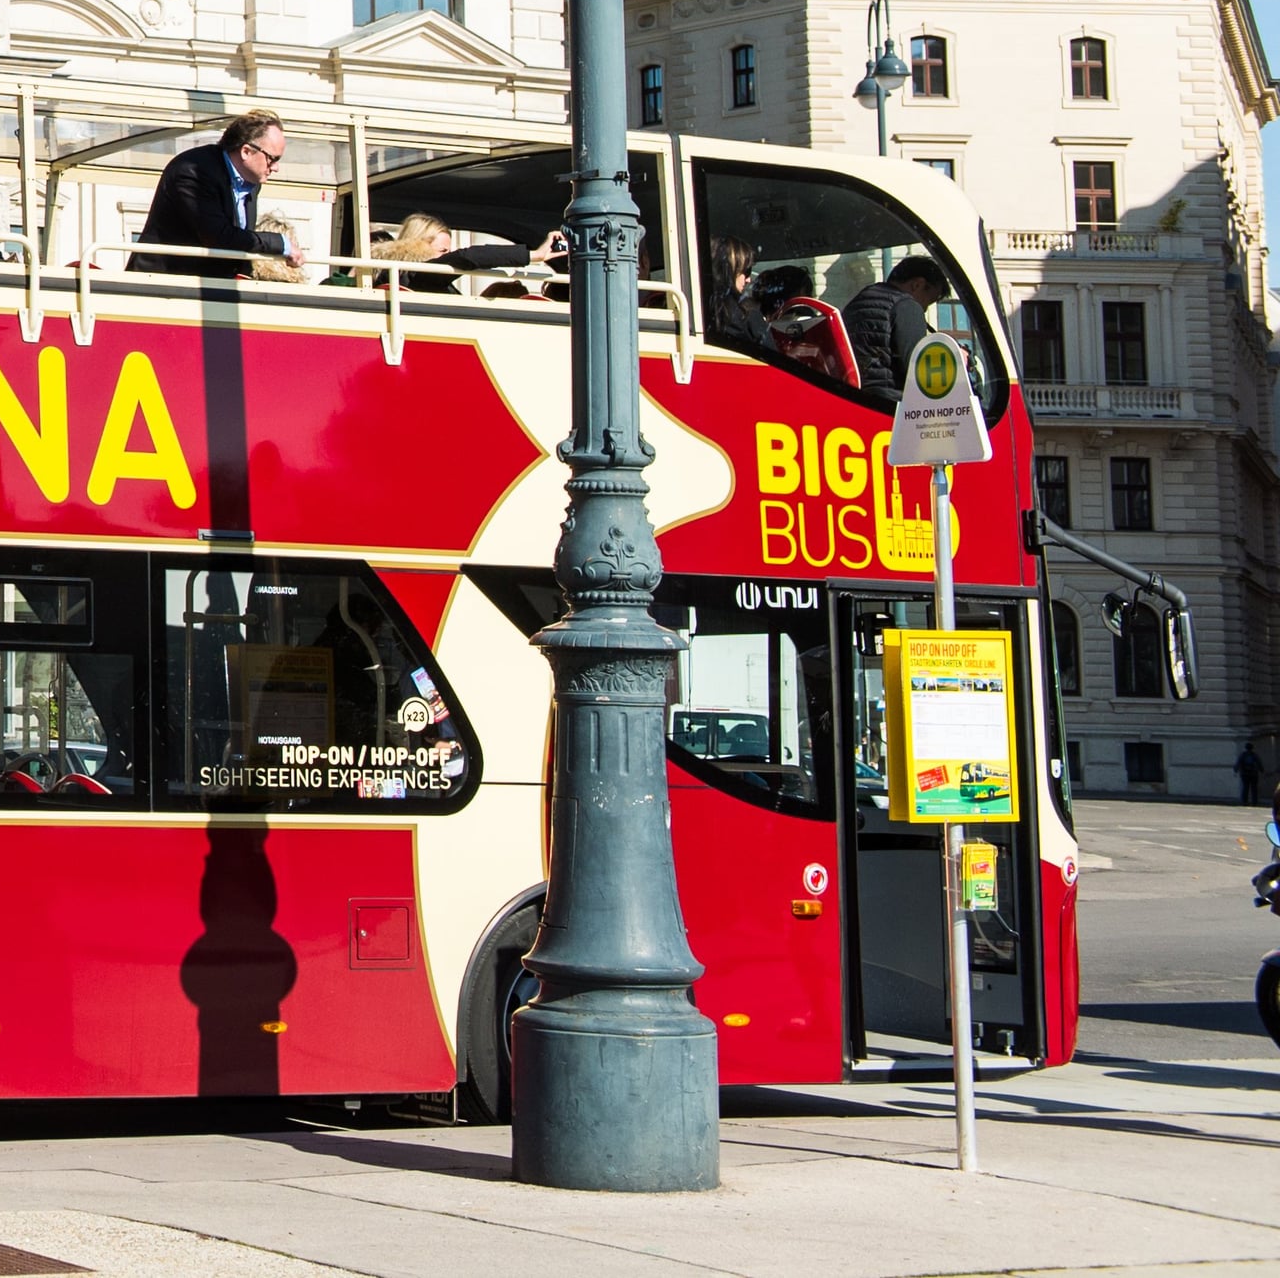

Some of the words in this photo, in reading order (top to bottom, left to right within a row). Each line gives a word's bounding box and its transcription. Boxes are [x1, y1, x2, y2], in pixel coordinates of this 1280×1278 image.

[924, 353, 947, 388] H
[904, 409, 921, 420] HOP
[923, 408, 935, 418] ON
[937, 407, 954, 418] HOP
[955, 406, 971, 416] OFF
[920, 430, 940, 440] CIRCLE
[942, 429, 956, 439] LINE
[755, 422, 868, 499] BIG
[760, 500, 873, 569] BUS
[910, 643, 928, 657] HOP
[929, 643, 941, 657] ON
[942, 643, 960, 657] HOP
[961, 644, 977, 658] OFF
[964, 659, 983, 669] CIRCLE
[984, 660, 996, 669] LINE
[406, 711, 425, 722] x23
[282, 745, 354, 765] HOP-ON
[370, 746, 452, 767] HOP-OFF
[200, 766, 322, 787] SIGHTSEEING
[327, 768, 452, 789] EXPERIENCES
